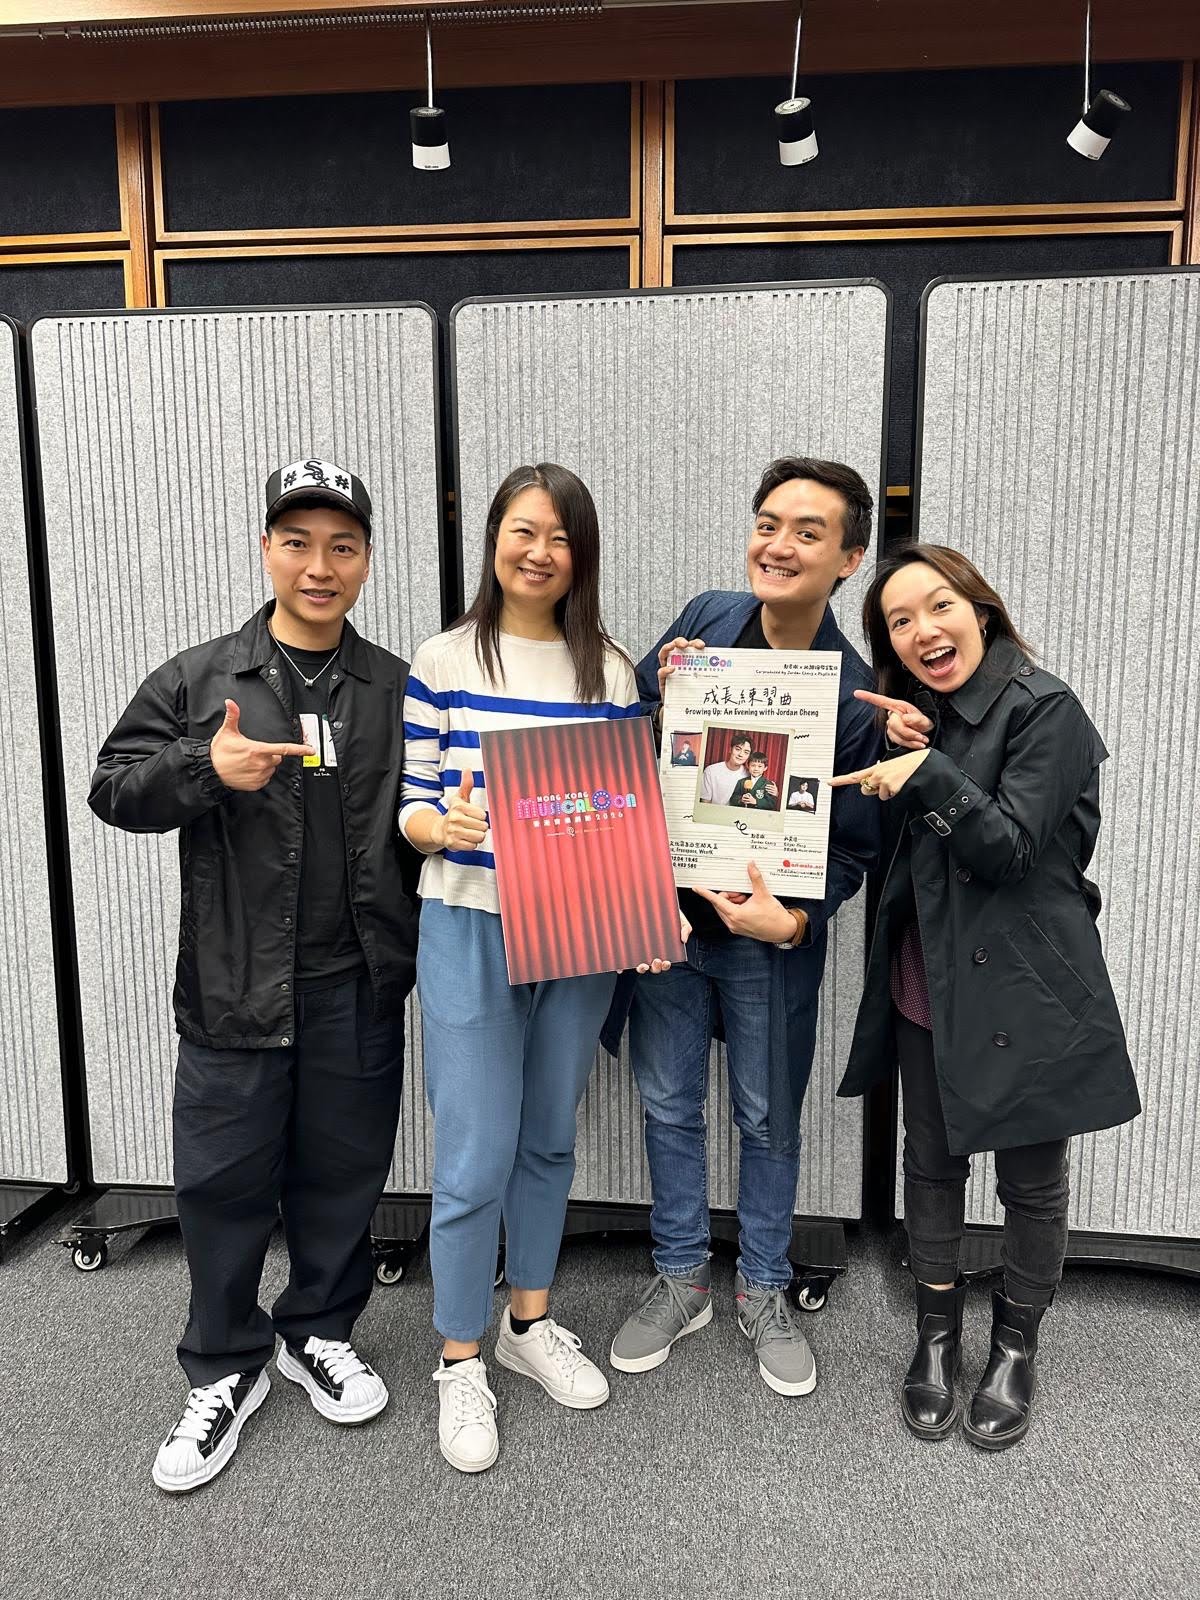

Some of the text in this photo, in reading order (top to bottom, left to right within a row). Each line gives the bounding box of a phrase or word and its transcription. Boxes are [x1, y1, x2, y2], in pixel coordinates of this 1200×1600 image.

[703, 684, 792, 706] 成長練習曲
[685, 707, 711, 716] Growing
[712, 707, 722, 716] Up:
[734, 708, 758, 717] Evening
[759, 708, 775, 716] with
[776, 708, 798, 716] Jordan
[799, 708, 819, 717] Cheng
[537, 791, 589, 803] HONG KONG
[595, 811, 623, 821] 2026
